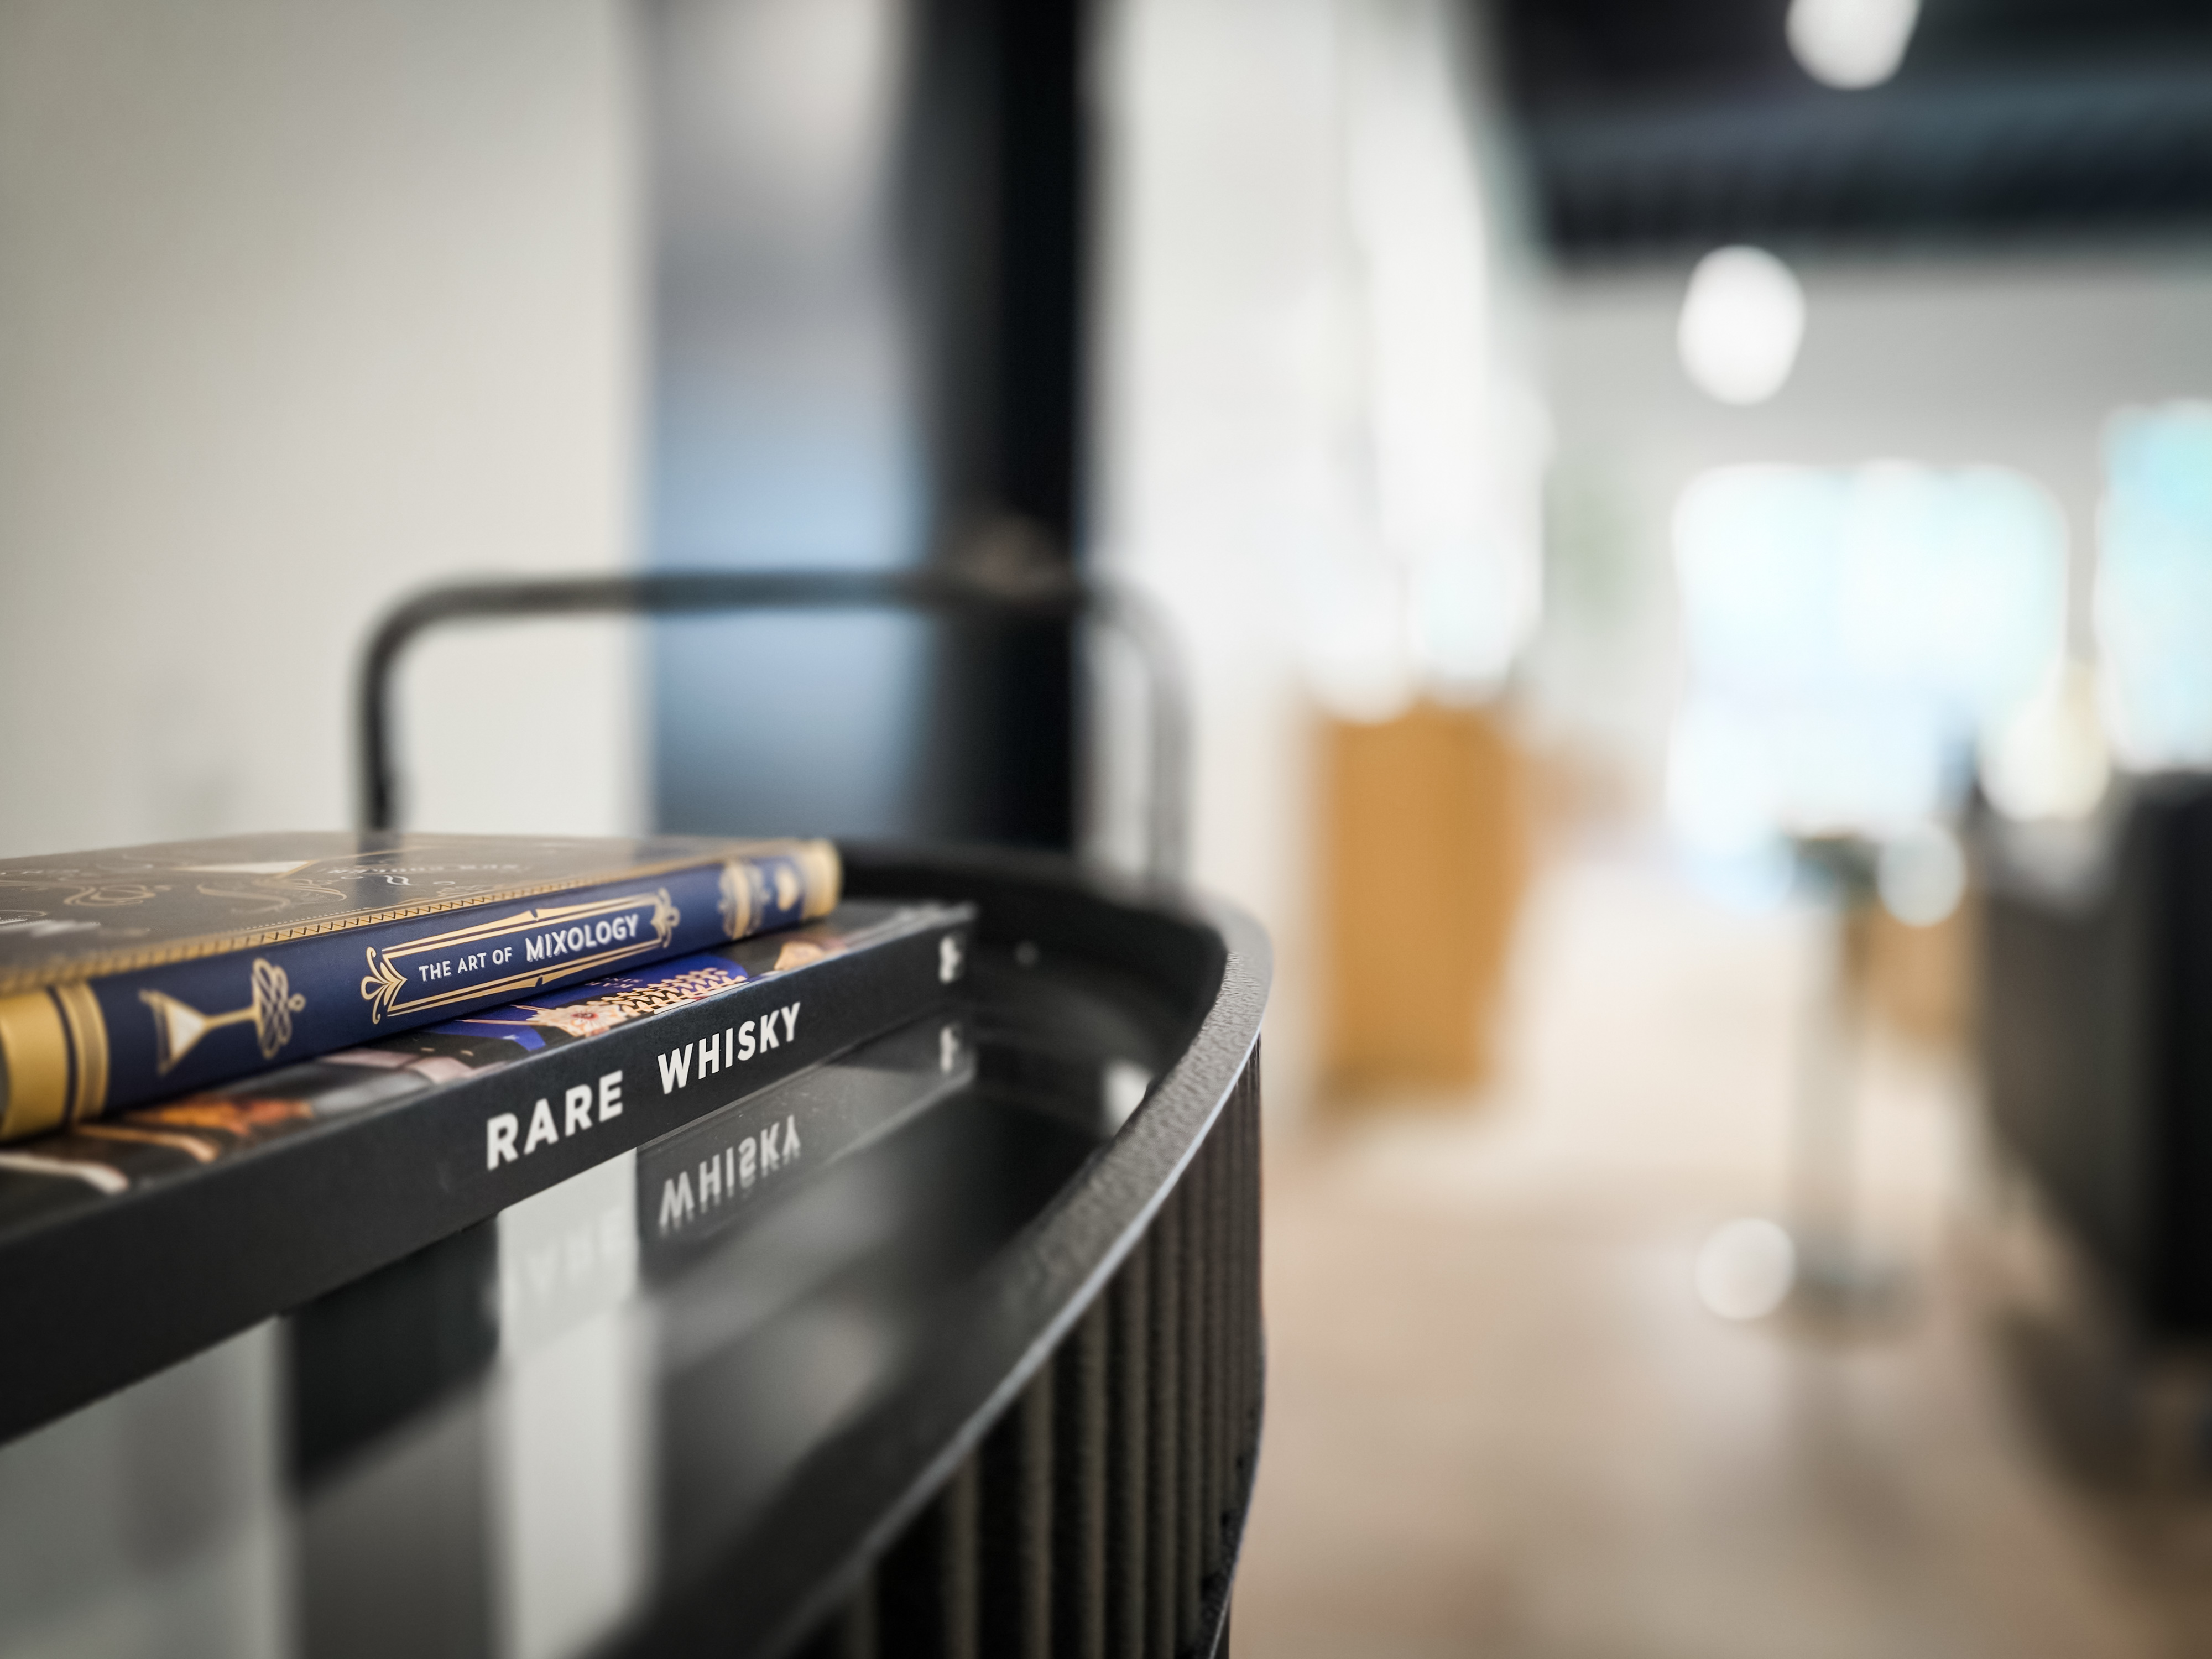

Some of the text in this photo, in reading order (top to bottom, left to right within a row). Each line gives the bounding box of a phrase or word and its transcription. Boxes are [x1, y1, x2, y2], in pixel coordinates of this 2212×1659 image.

[419, 914, 639, 982] THE ART OF MIXOLOGY
[487, 1002, 800, 1171] RARE WHISKY
